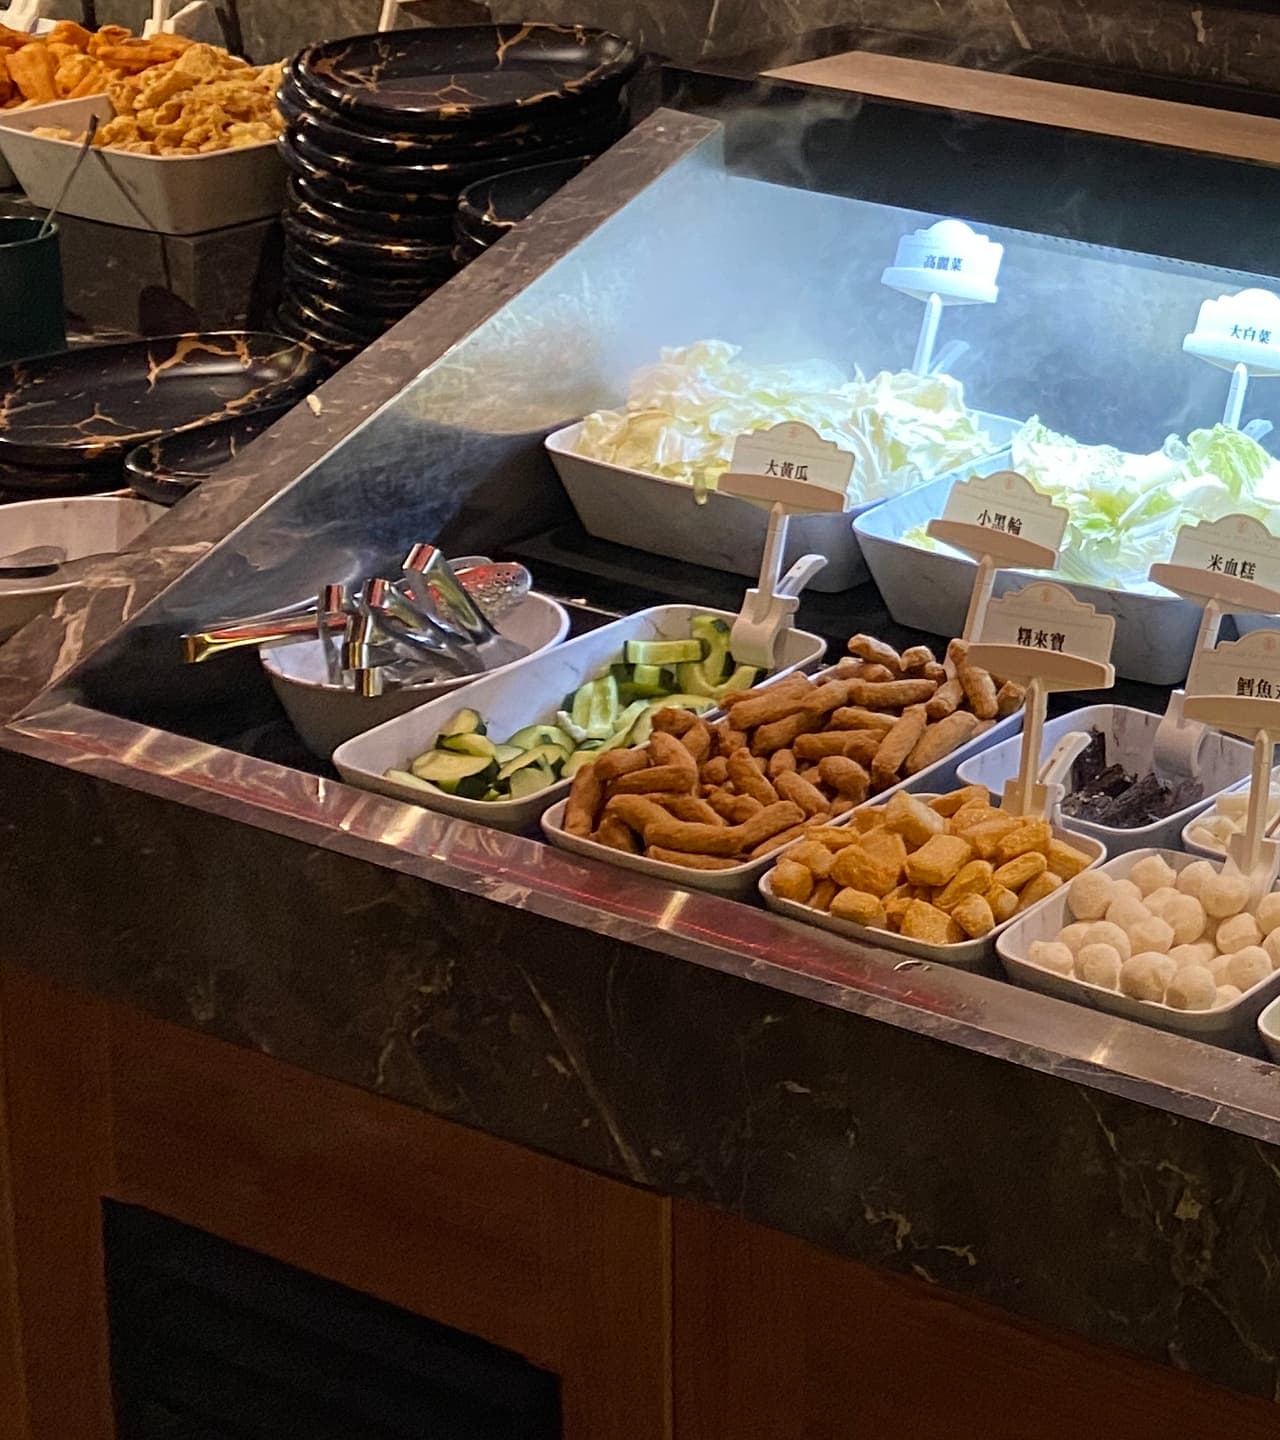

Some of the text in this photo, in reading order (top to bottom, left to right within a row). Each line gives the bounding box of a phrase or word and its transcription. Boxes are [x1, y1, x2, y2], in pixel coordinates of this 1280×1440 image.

[923, 254, 964, 272] 高麗菜
[1230, 324, 1272, 345] 大白菜
[1207, 553, 1257, 581] 米血糕
